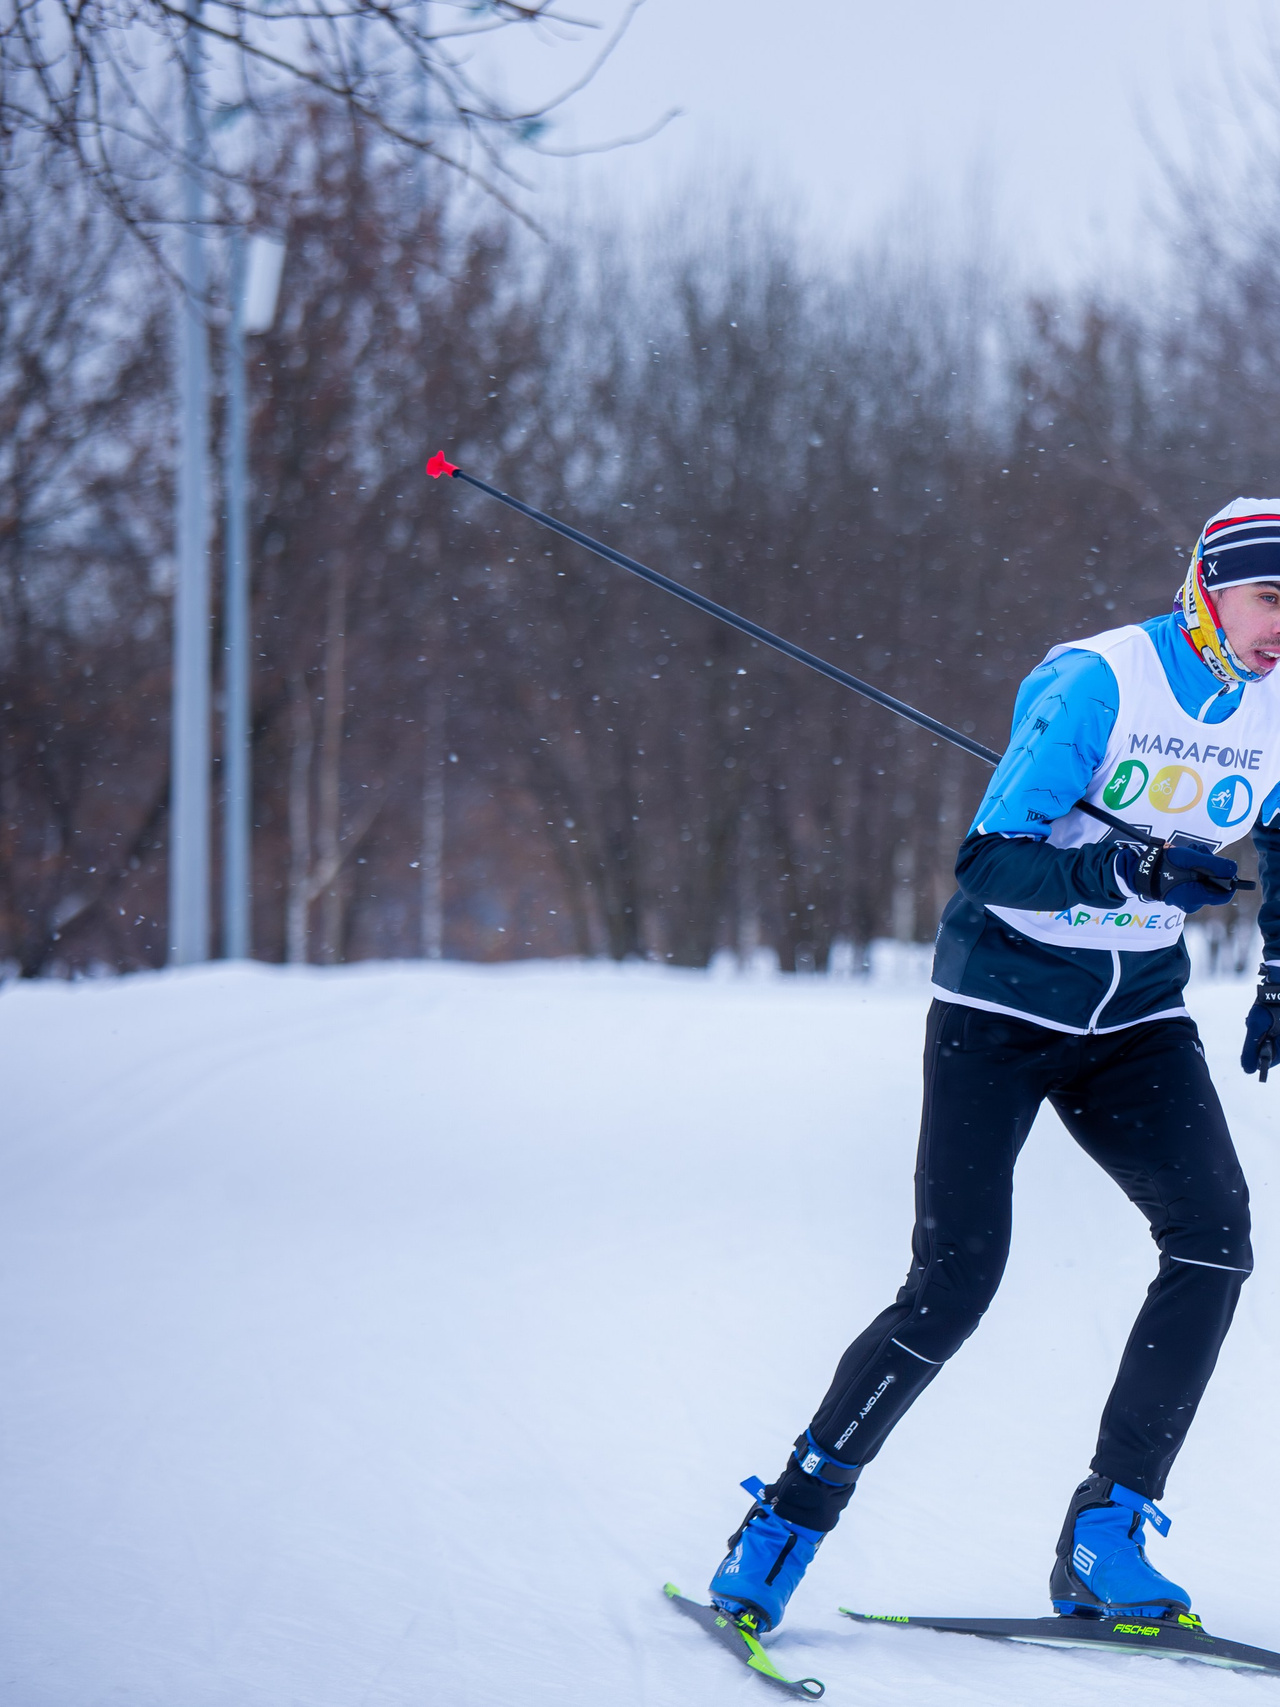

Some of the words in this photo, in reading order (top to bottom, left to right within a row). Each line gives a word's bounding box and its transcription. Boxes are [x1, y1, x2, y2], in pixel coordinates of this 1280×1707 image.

[1207, 560, 1218, 577] X
[1129, 733, 1263, 770] MARAFONE
[1142, 847, 1159, 875] MOAX
[859, 1375, 894, 1419] VICTORY
[834, 1420, 859, 1450] CODE
[1113, 1623, 1160, 1637] FISCHER
